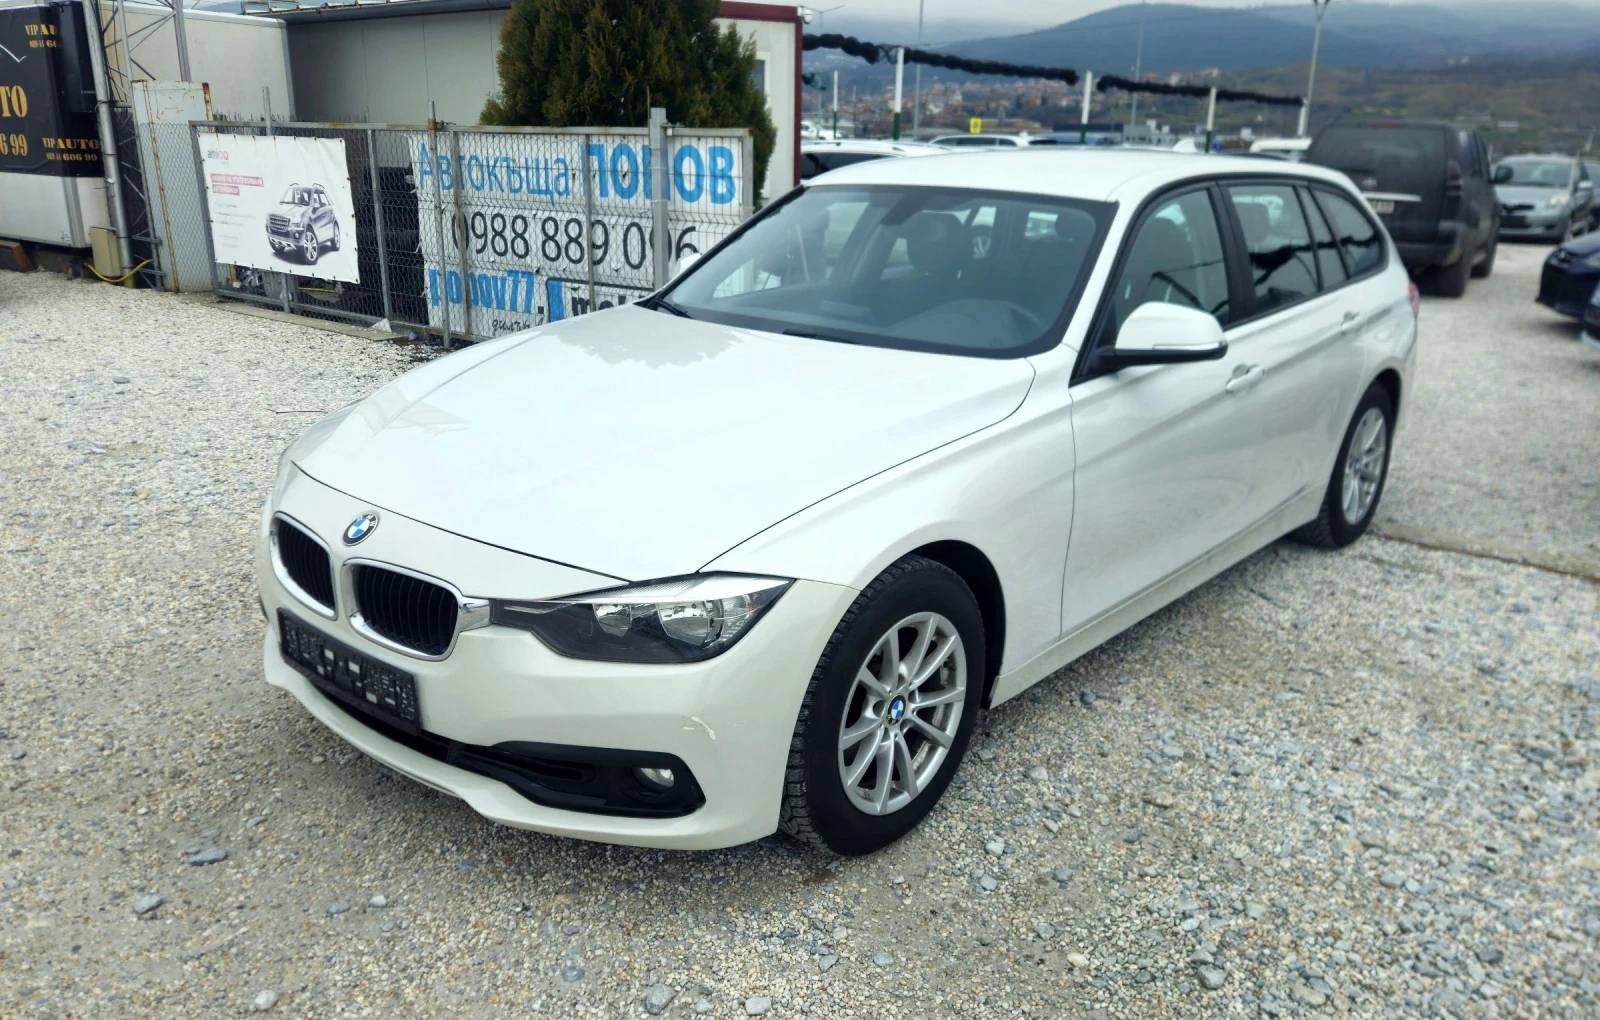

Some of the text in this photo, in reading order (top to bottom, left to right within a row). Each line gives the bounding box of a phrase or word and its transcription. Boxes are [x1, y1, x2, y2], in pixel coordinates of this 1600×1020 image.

[9, 134, 28, 157] 99
[56, 138, 99, 150] AUTO
[452, 211, 530, 259] 0988
[541, 216, 609, 266] 889
